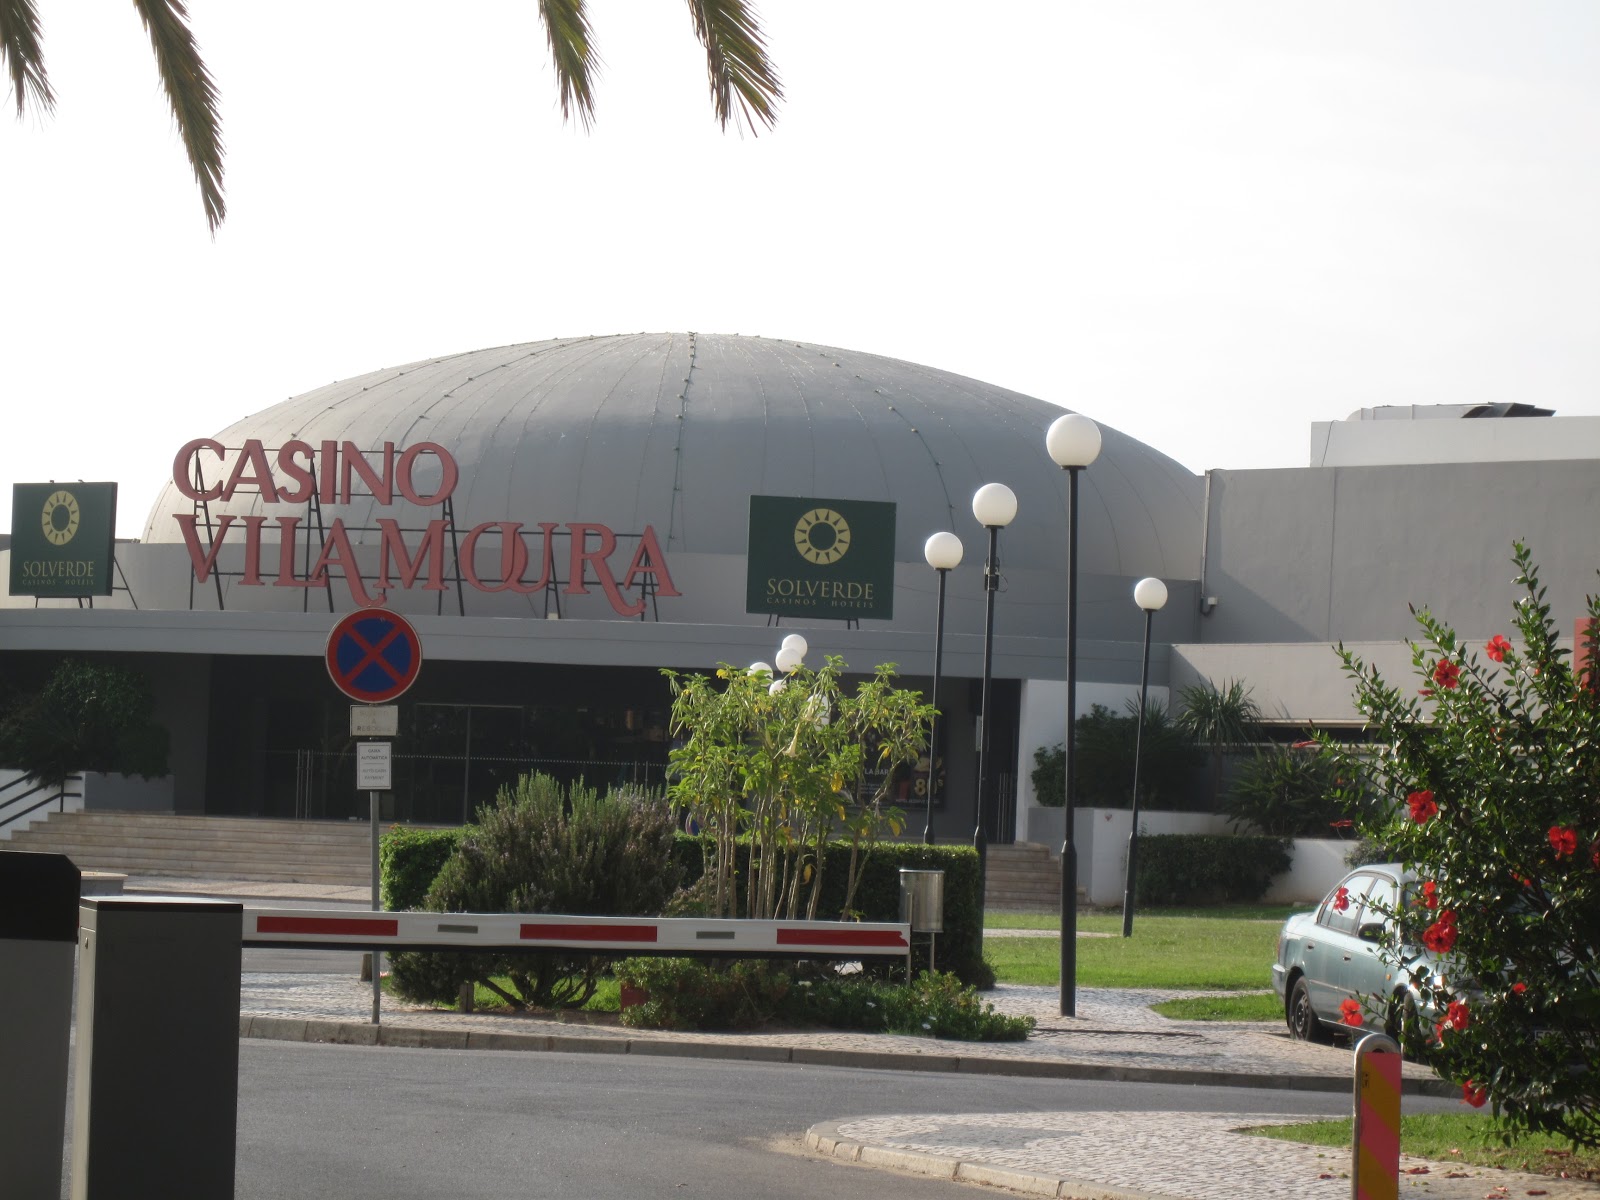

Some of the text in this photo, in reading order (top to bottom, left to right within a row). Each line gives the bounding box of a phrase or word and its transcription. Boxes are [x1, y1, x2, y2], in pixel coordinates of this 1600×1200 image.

[172, 438, 459, 506] CASINO
[22, 560, 96, 577] SOLVERDE
[172, 514, 683, 617] VILAMOURA
[766, 578, 874, 600] SOLVERDE
[766, 597, 817, 607] CASINOS
